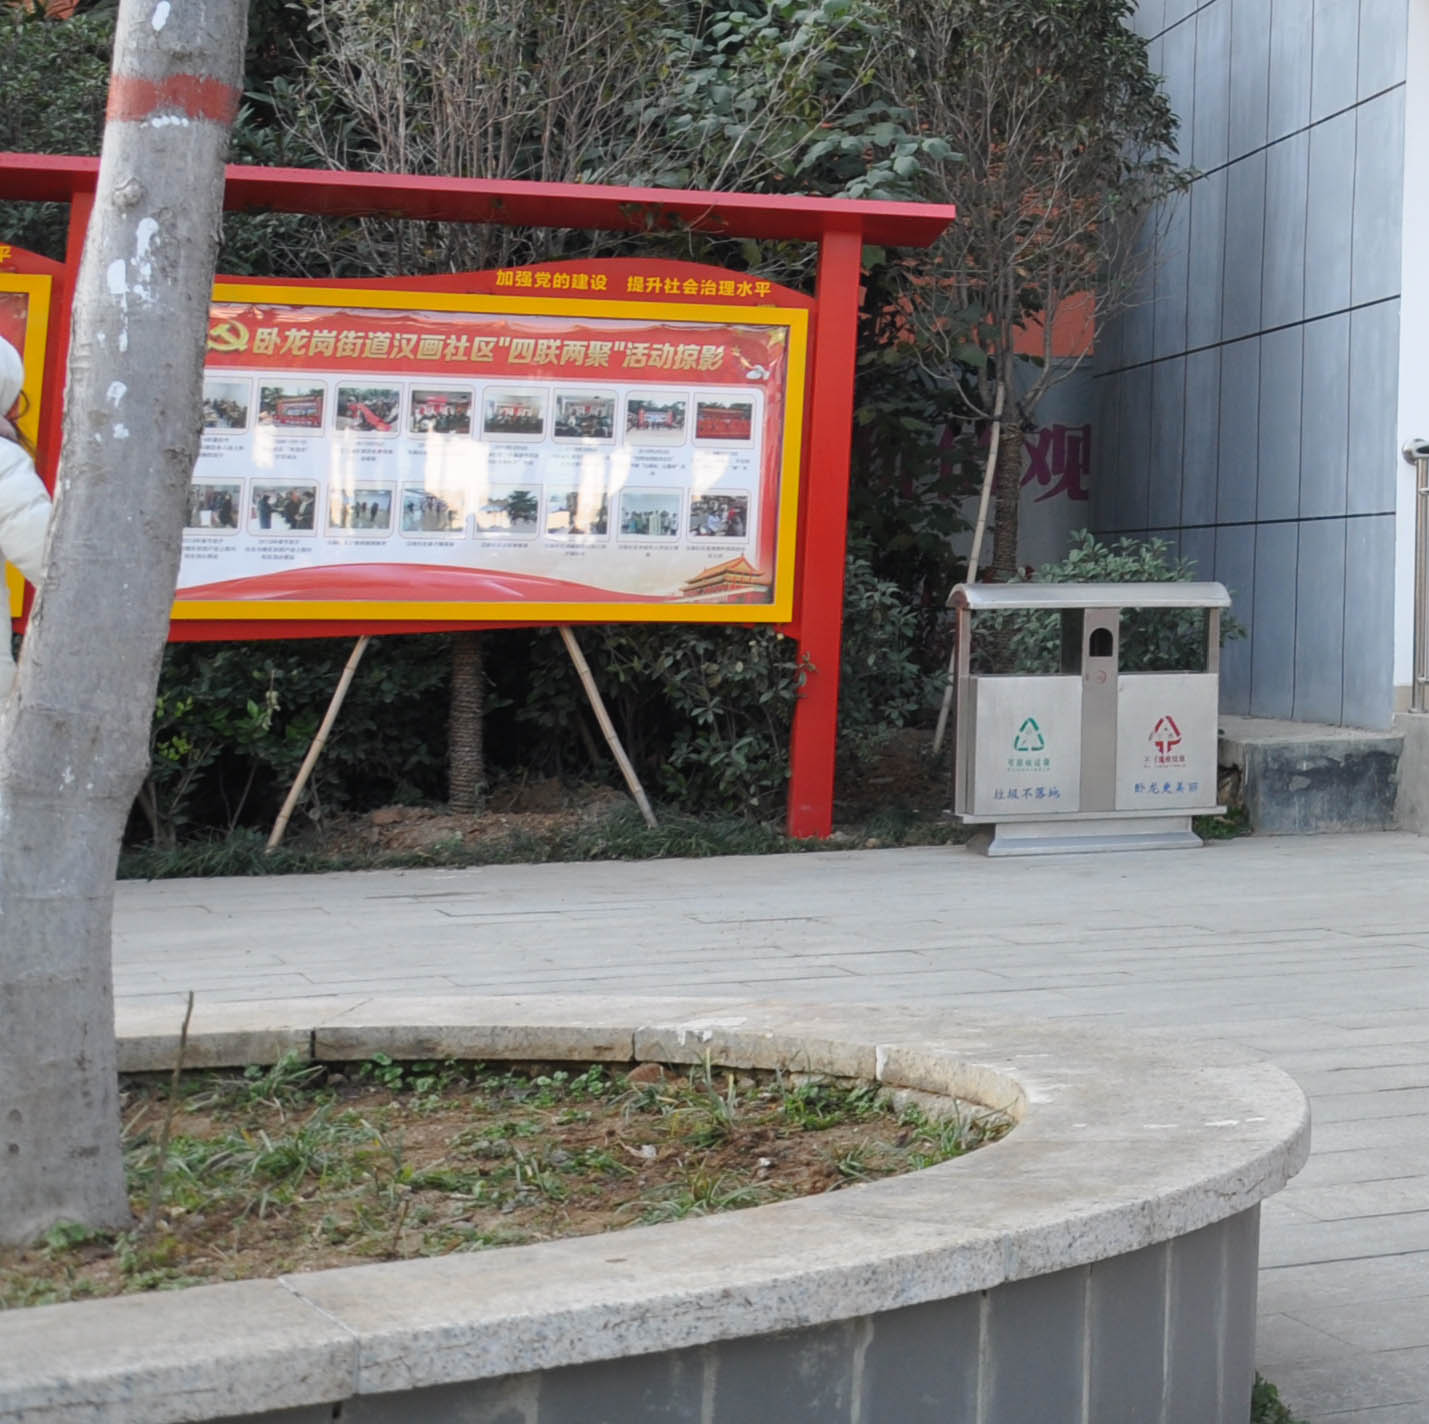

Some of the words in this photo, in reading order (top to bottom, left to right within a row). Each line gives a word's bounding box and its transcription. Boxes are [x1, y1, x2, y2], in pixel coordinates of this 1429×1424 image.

[496, 270, 608, 291] 加强党的建设
[626, 275, 772, 298] 提升社会治理水平
[1133, 780, 1200, 795] 卧龙更美丽
